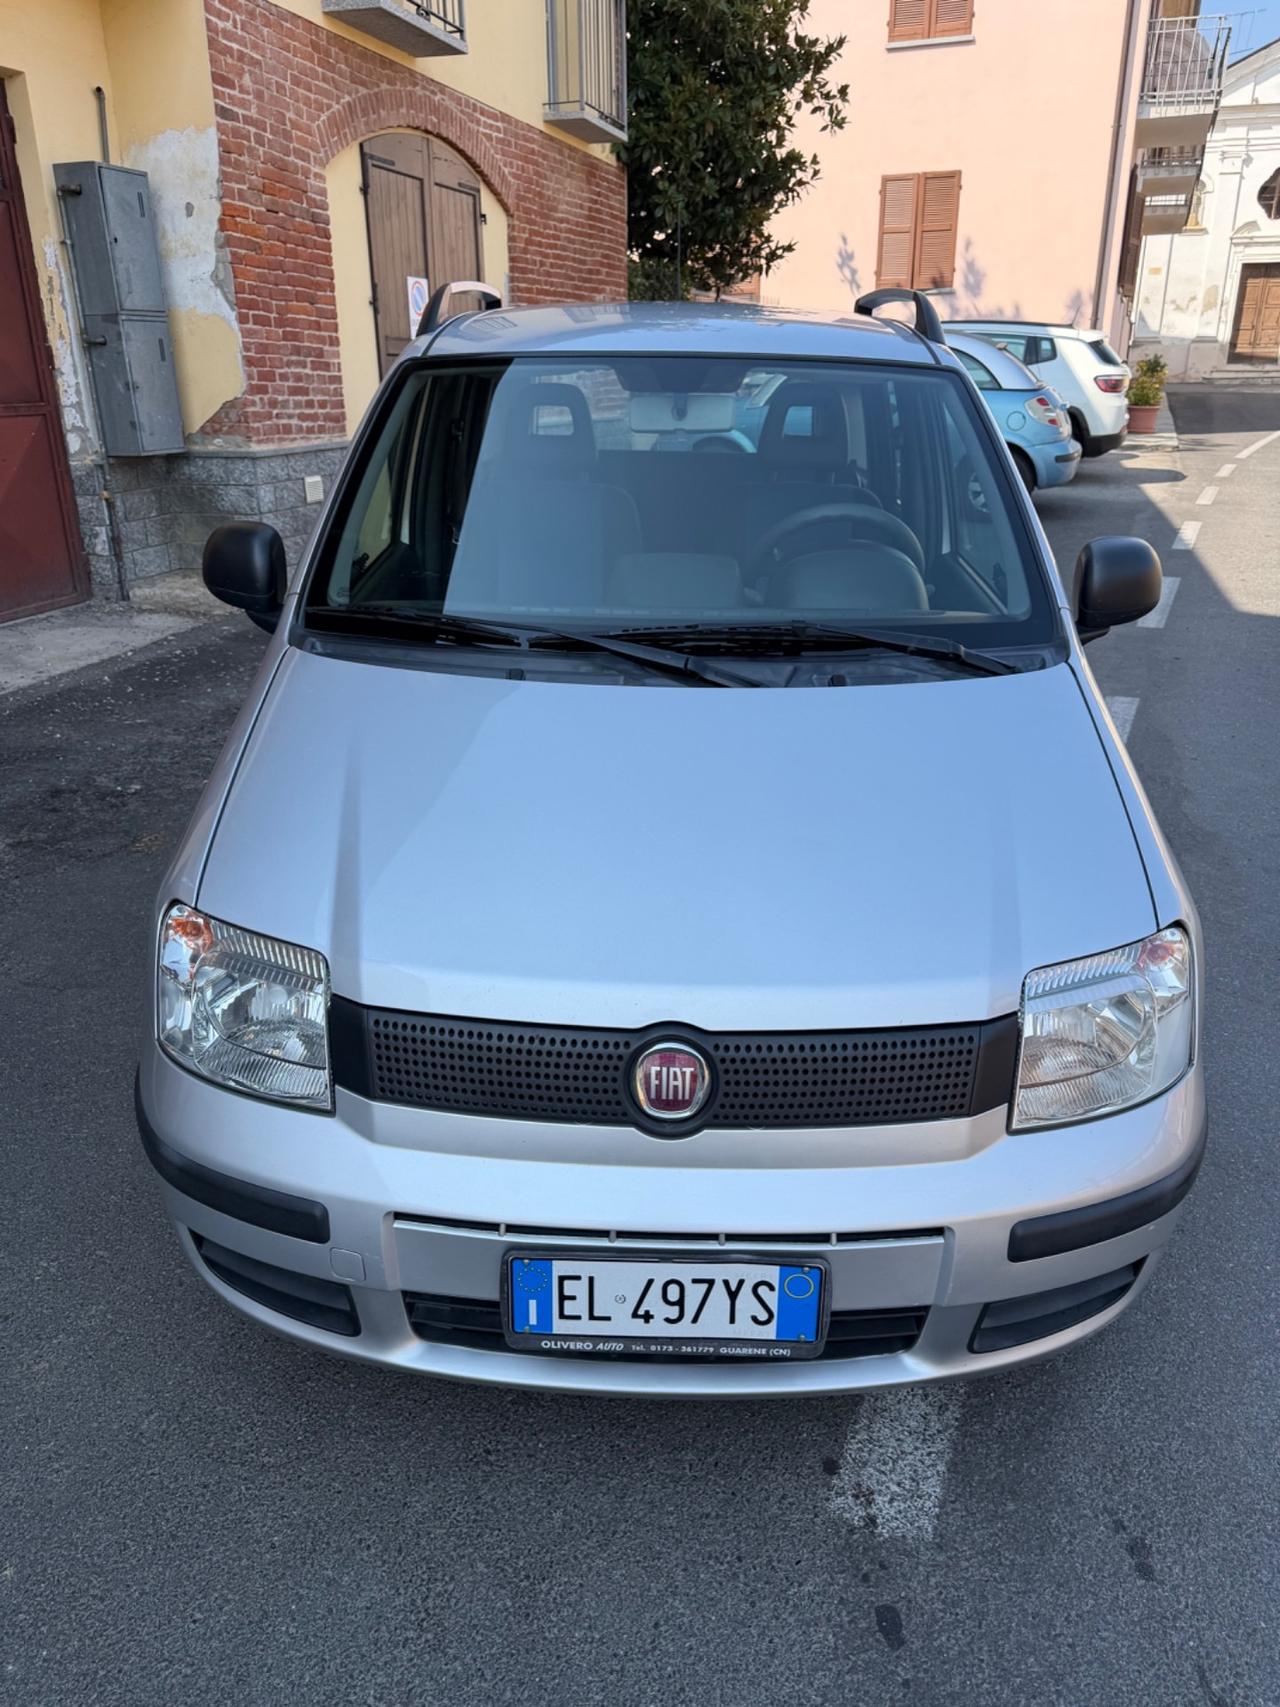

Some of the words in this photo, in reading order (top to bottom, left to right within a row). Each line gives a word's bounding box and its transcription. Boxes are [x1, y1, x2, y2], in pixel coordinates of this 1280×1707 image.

[650, 1066, 694, 1100] FIAT
[528, 1299, 537, 1325] I
[557, 1274, 612, 1321] EL
[631, 1278, 776, 1327] 497YS
[541, 1340, 593, 1350] OLIVERO
[596, 1342, 624, 1351] AUTO
[720, 1347, 767, 1355] GUARENE
[769, 1348, 791, 1357] (CN)
